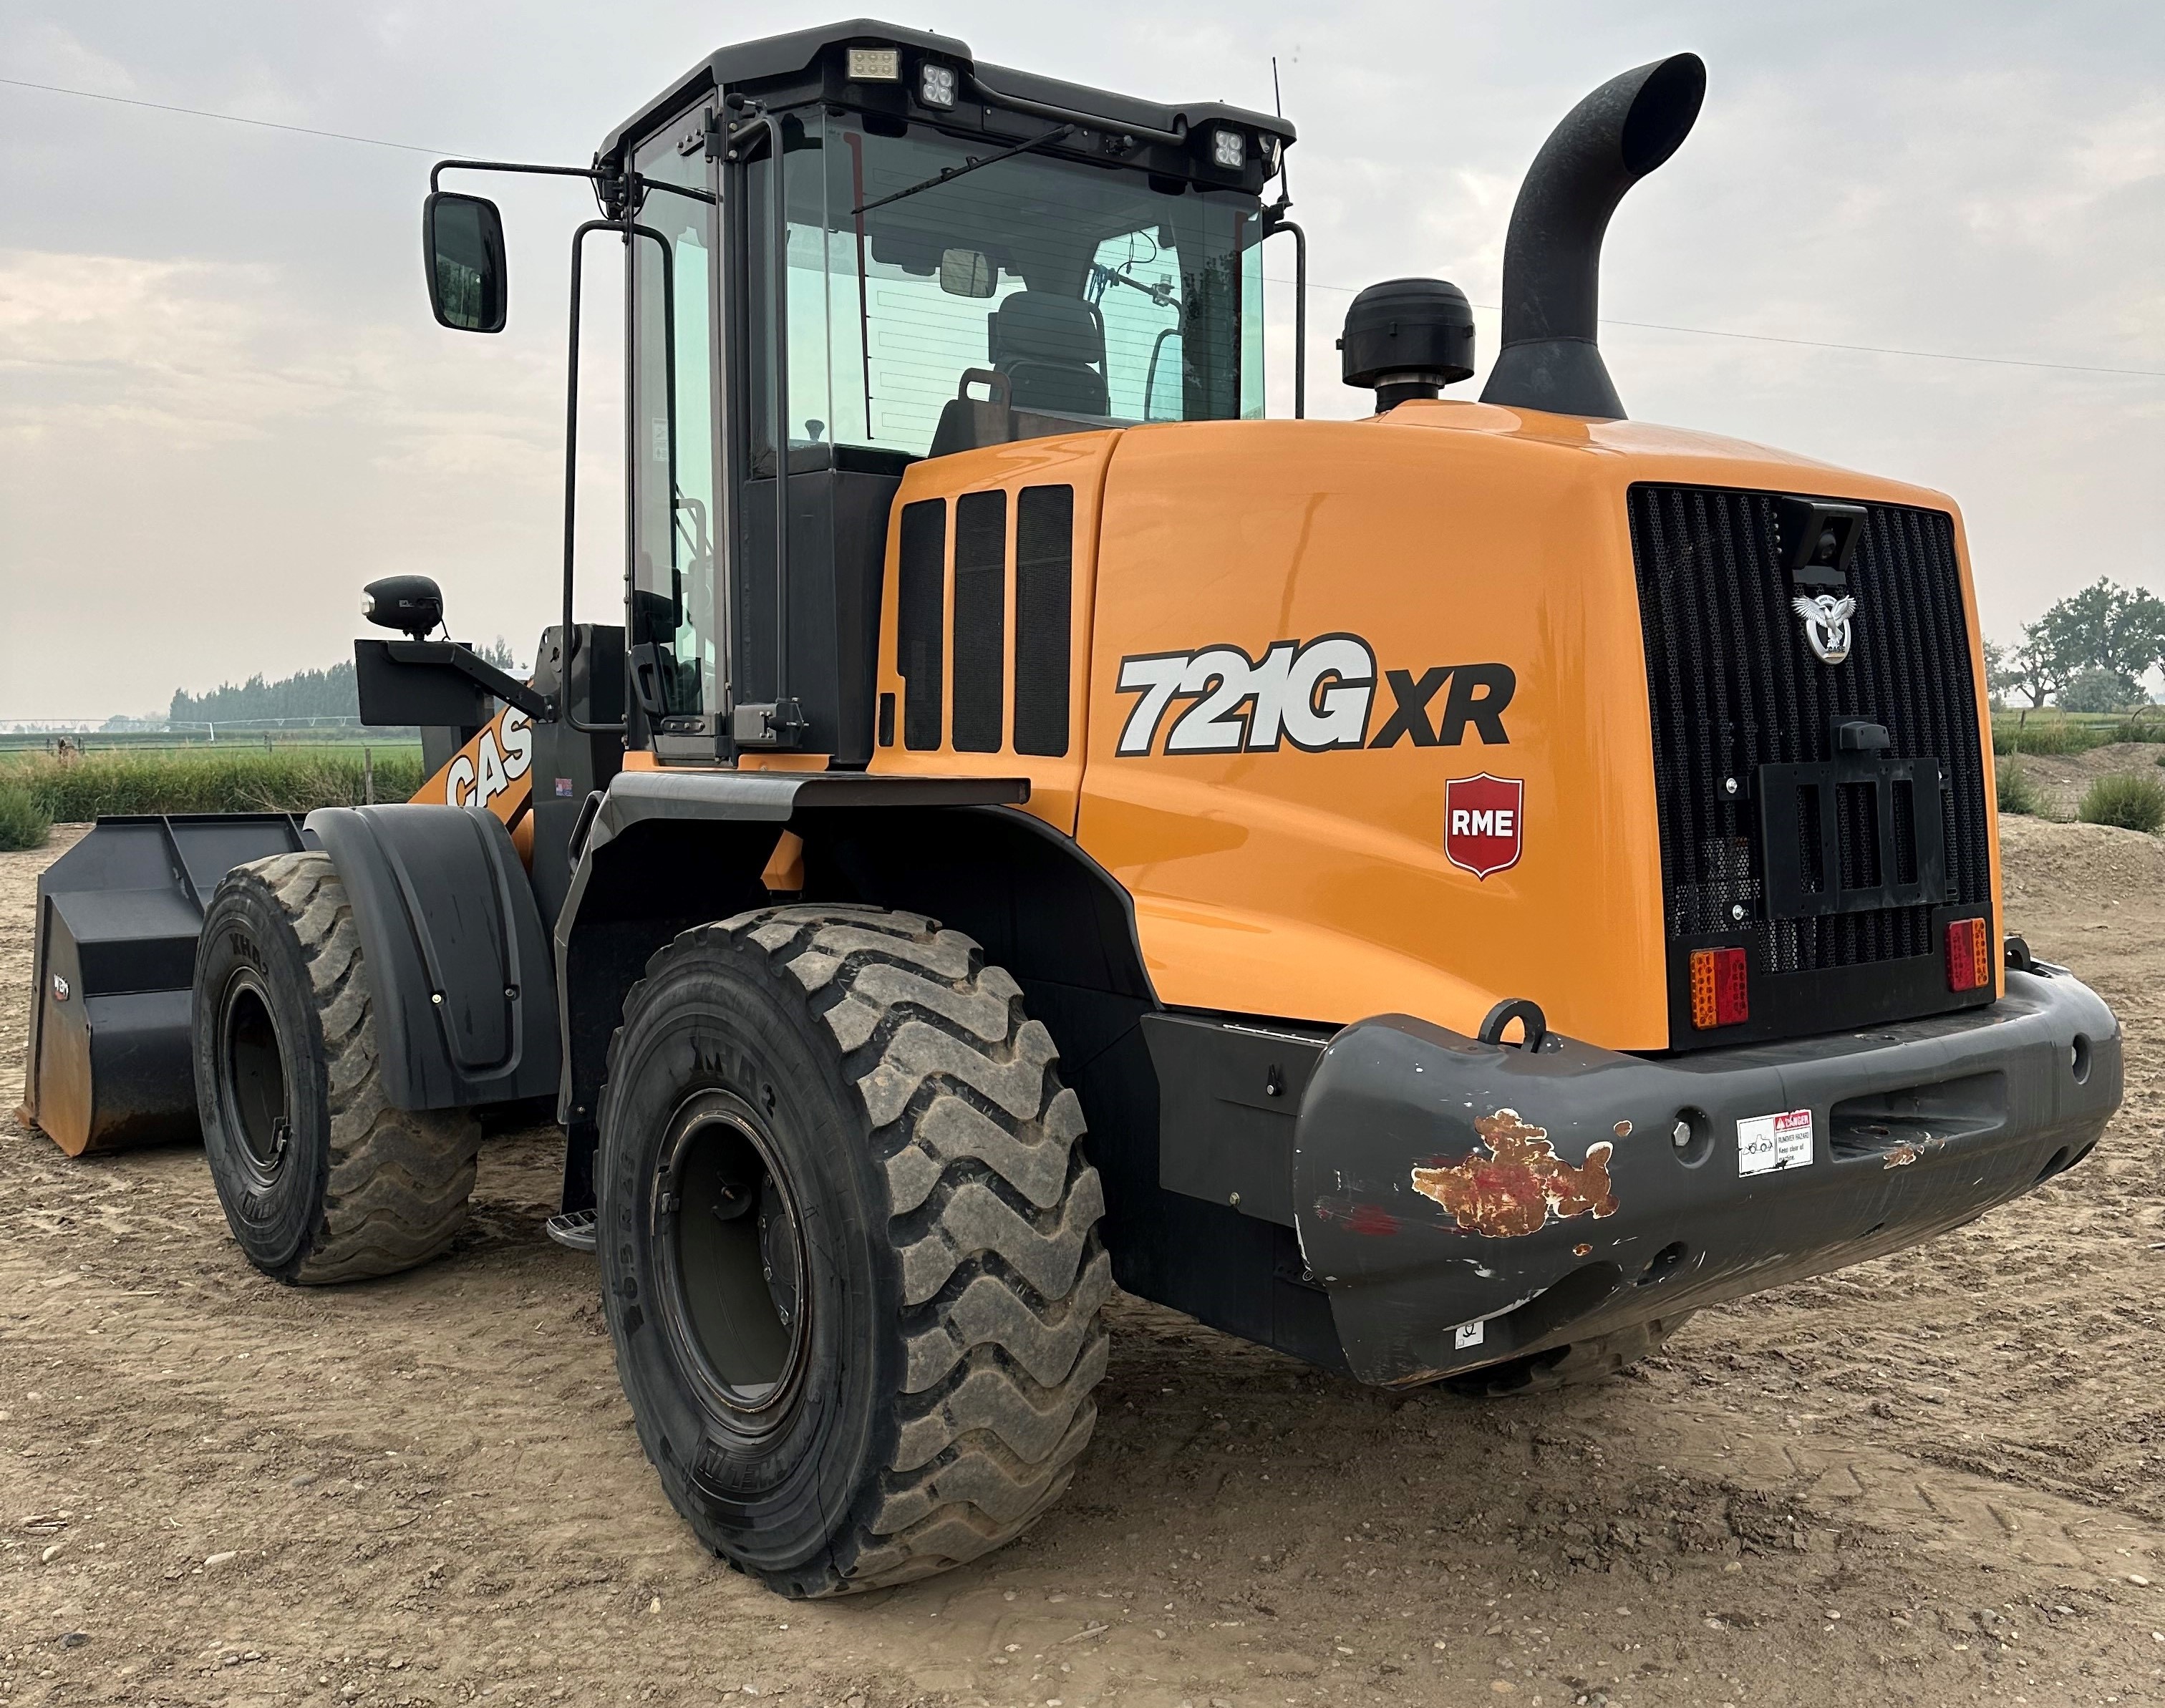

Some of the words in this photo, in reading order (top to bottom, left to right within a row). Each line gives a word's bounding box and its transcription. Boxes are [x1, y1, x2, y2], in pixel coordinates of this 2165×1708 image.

[1115, 632, 1377, 757] 721G
[1367, 662, 1516, 749] XR
[1451, 809, 1513, 837] RME
[1785, 1115, 1808, 1127] DANGER
